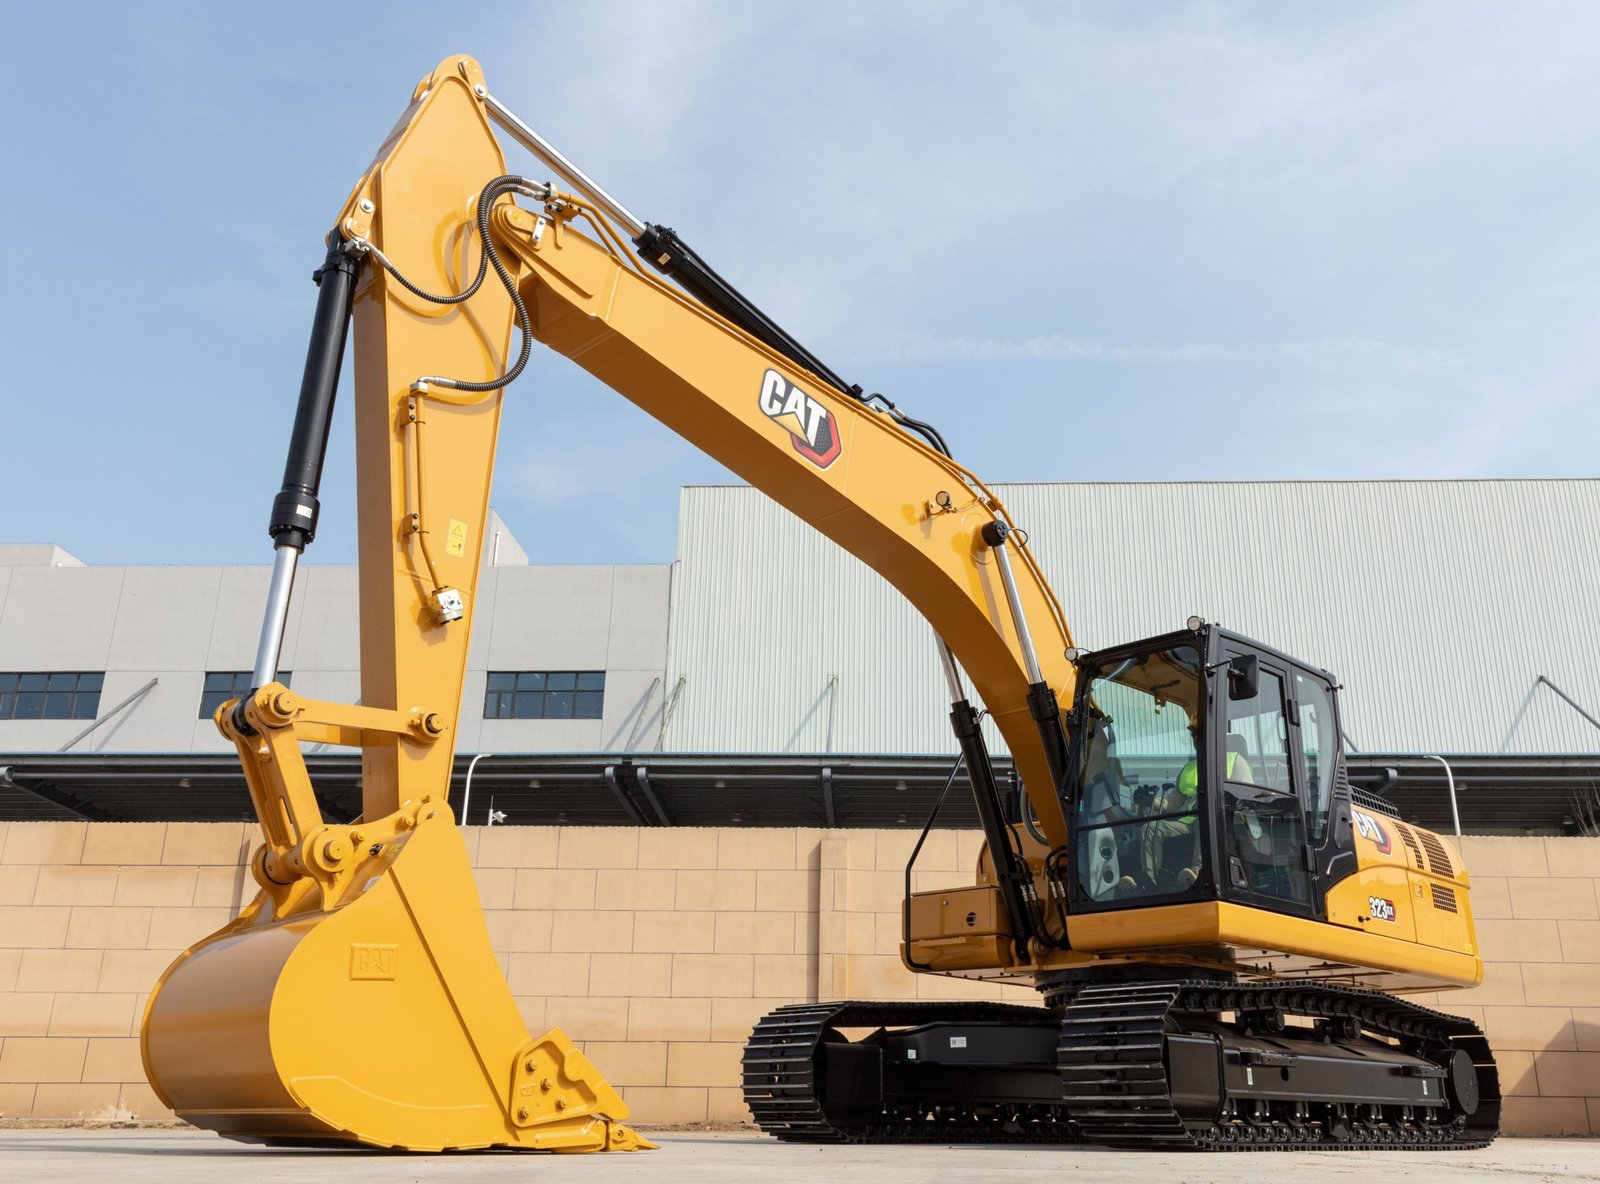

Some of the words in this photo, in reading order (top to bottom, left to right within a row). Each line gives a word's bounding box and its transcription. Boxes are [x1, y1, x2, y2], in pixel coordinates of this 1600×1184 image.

[760, 369, 827, 447] CAT
[1351, 810, 1384, 844] CAT
[359, 947, 395, 976] CAT
